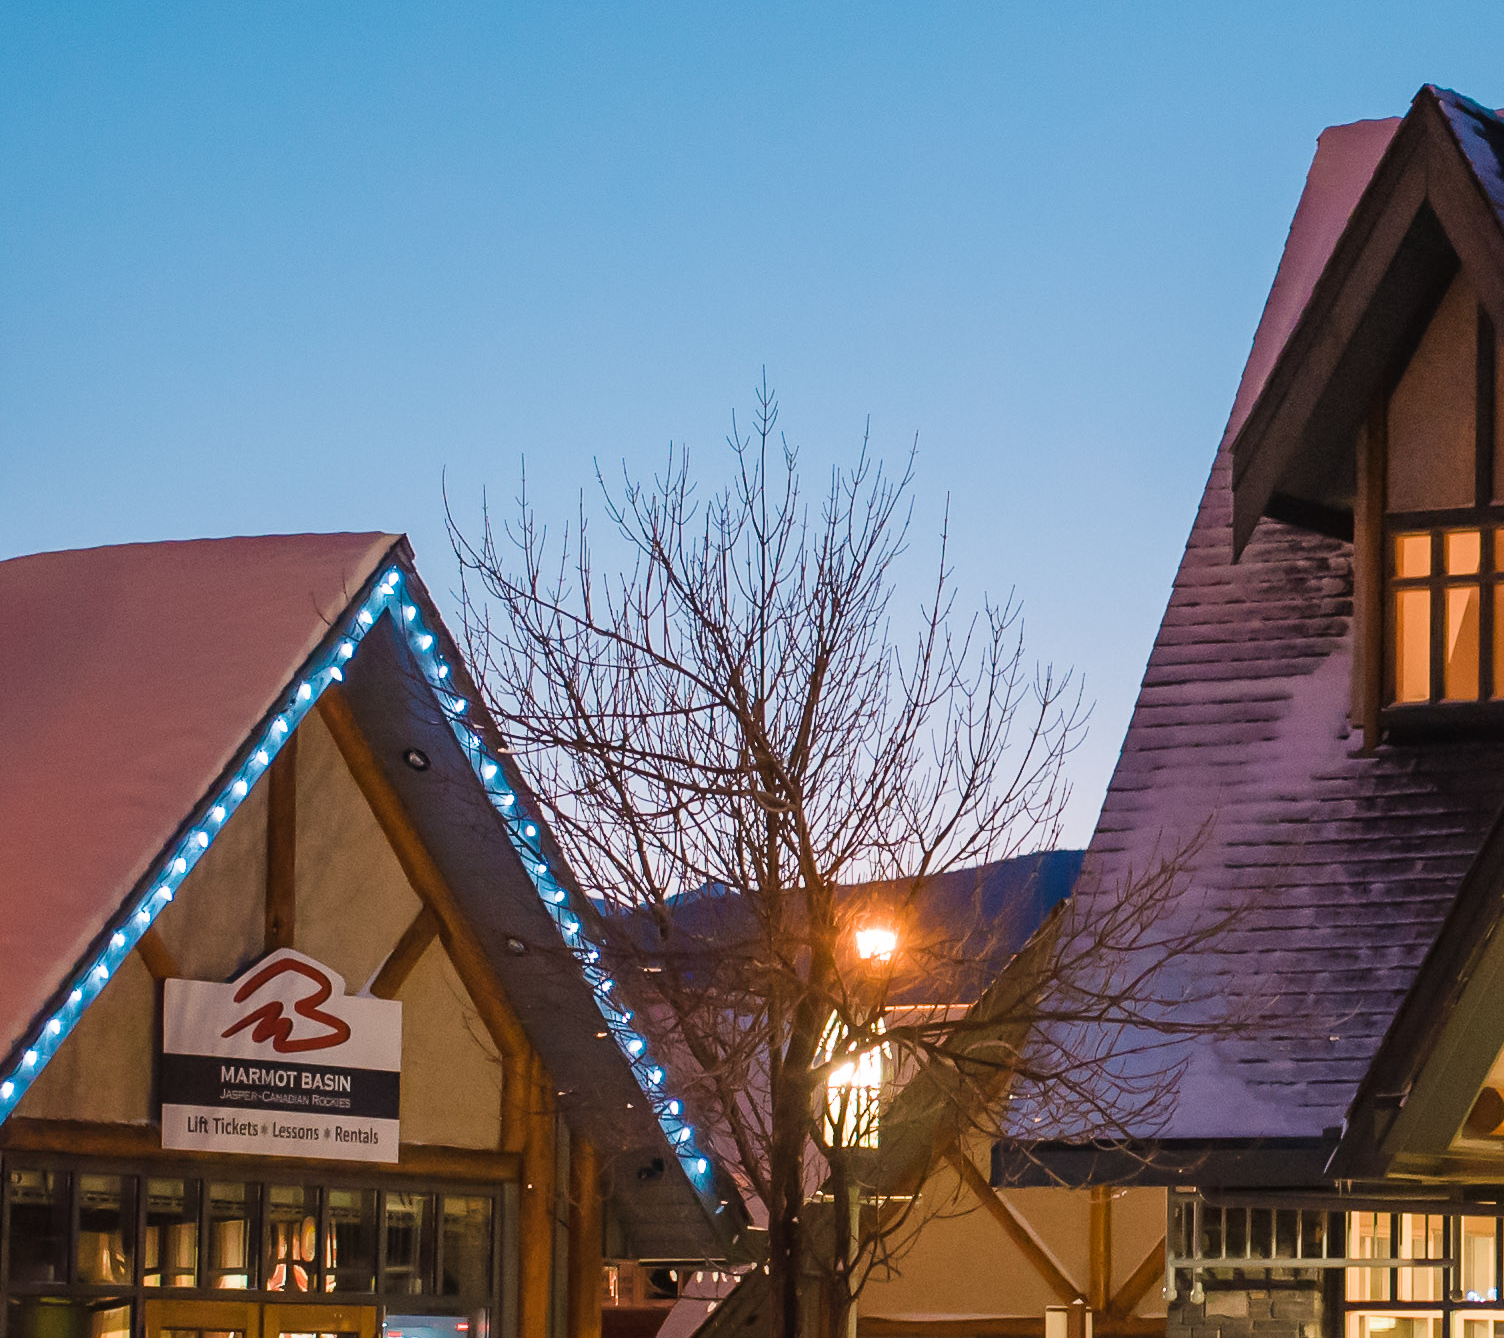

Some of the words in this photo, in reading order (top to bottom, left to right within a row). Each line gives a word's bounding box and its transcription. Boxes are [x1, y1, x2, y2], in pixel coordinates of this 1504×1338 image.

[220, 1065, 297, 1088] MARMOT
[301, 1072, 351, 1093] BASIN
[187, 1115, 209, 1134] Lift
[213, 1117, 259, 1136] Tickets
[272, 1121, 320, 1141] Lessons
[334, 1125, 379, 1145] Rentals
